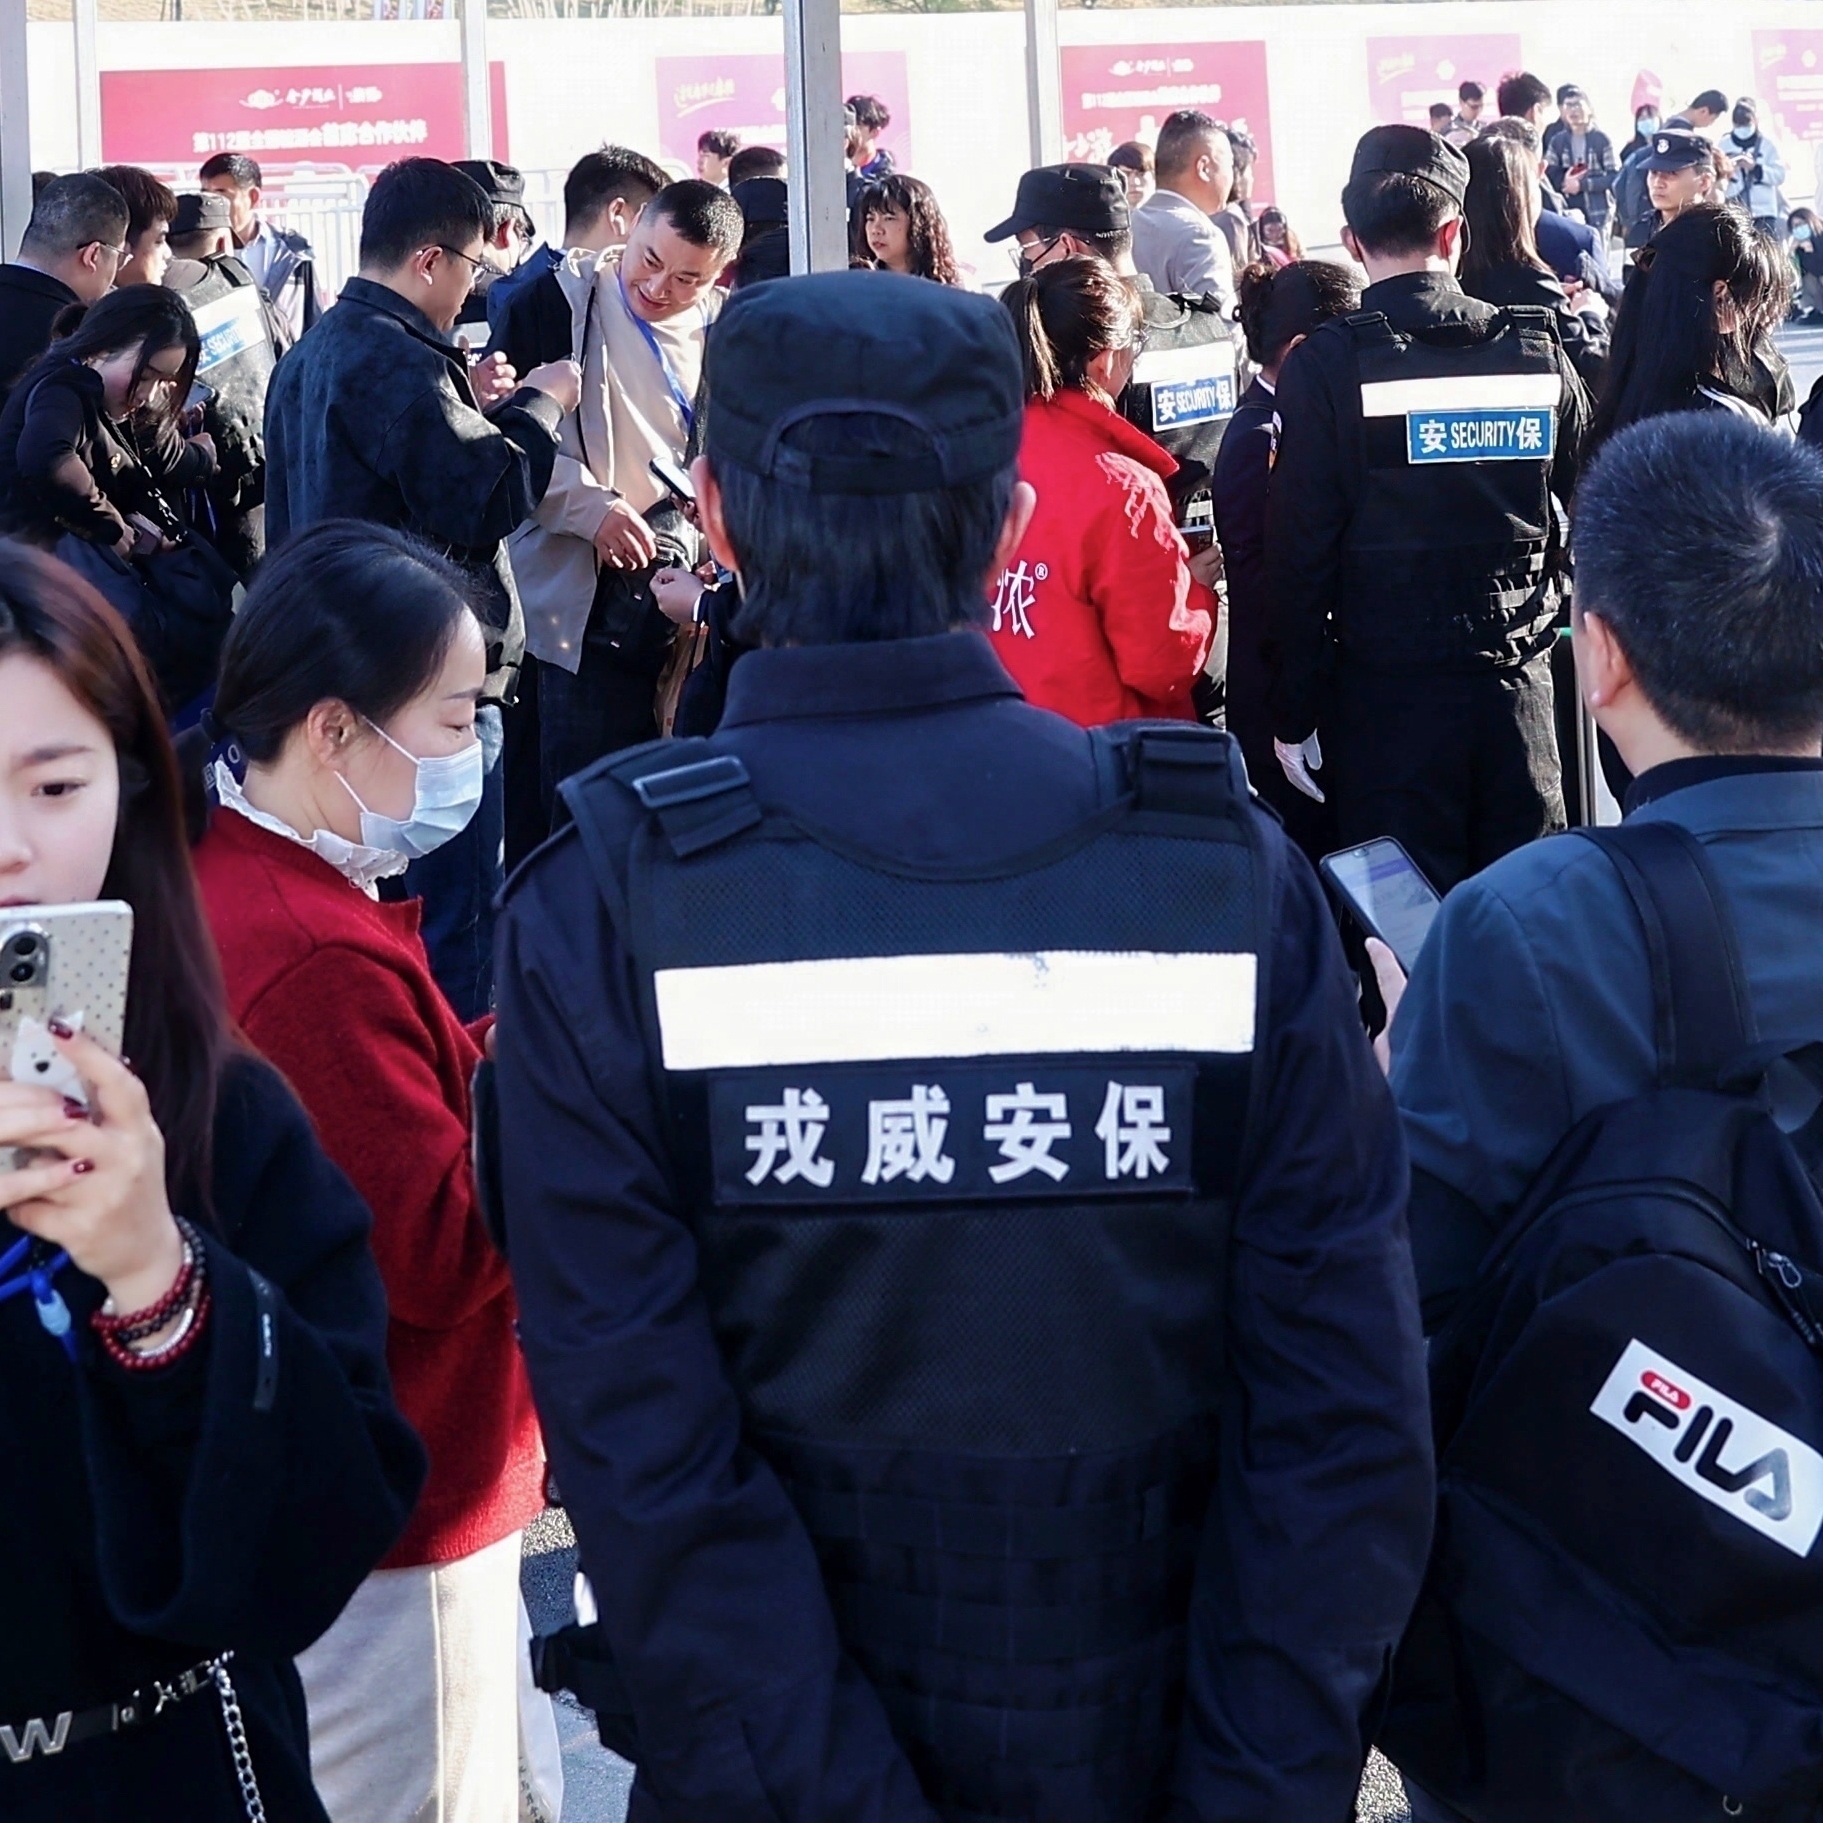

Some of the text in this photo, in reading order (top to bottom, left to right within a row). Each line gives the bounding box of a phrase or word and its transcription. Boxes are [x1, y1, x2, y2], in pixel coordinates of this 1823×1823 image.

[1156, 379, 1233, 422] 安 SECURITY 保
[1418, 414, 1543, 455] 安 SECURITY 保
[745, 1080, 1172, 1187] 戎威安保
[1650, 1376, 1680, 1404] FILA
[1623, 1389, 1793, 1522] FILA
